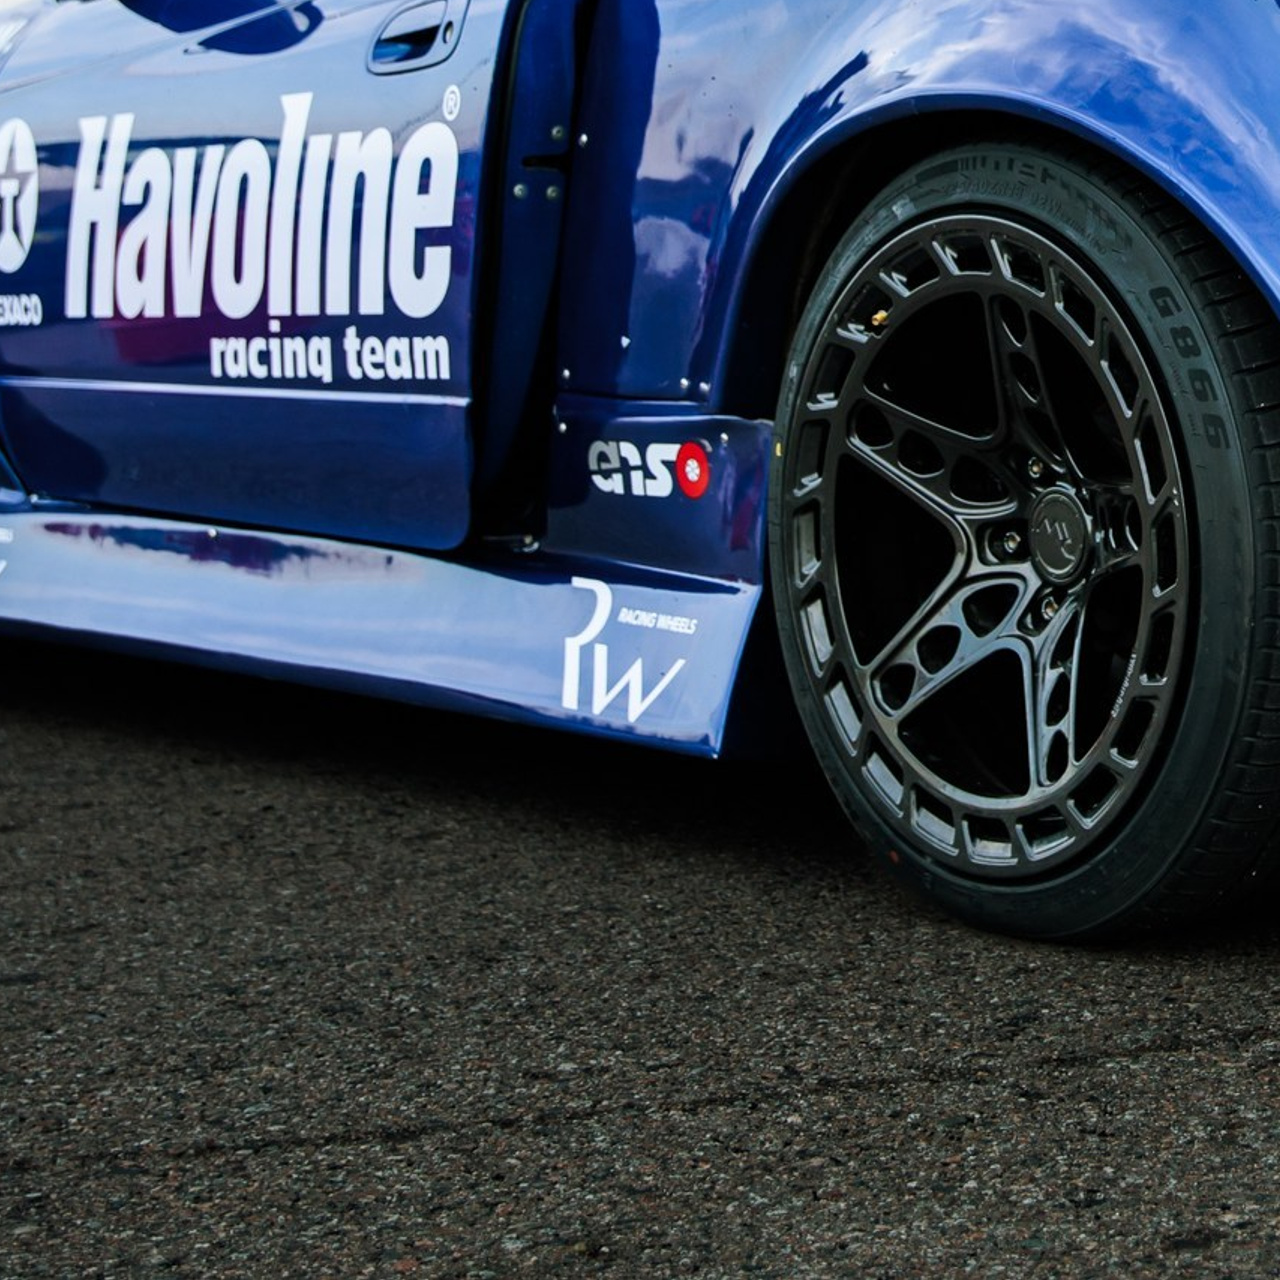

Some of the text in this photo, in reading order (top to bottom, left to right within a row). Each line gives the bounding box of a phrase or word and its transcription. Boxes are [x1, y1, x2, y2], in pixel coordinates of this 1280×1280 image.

[65, 93, 460, 319] Havoline
[211, 319, 451, 384] racing team
[1149, 286, 1231, 449] G866
[617, 607, 698, 635] RACING WHEELS
